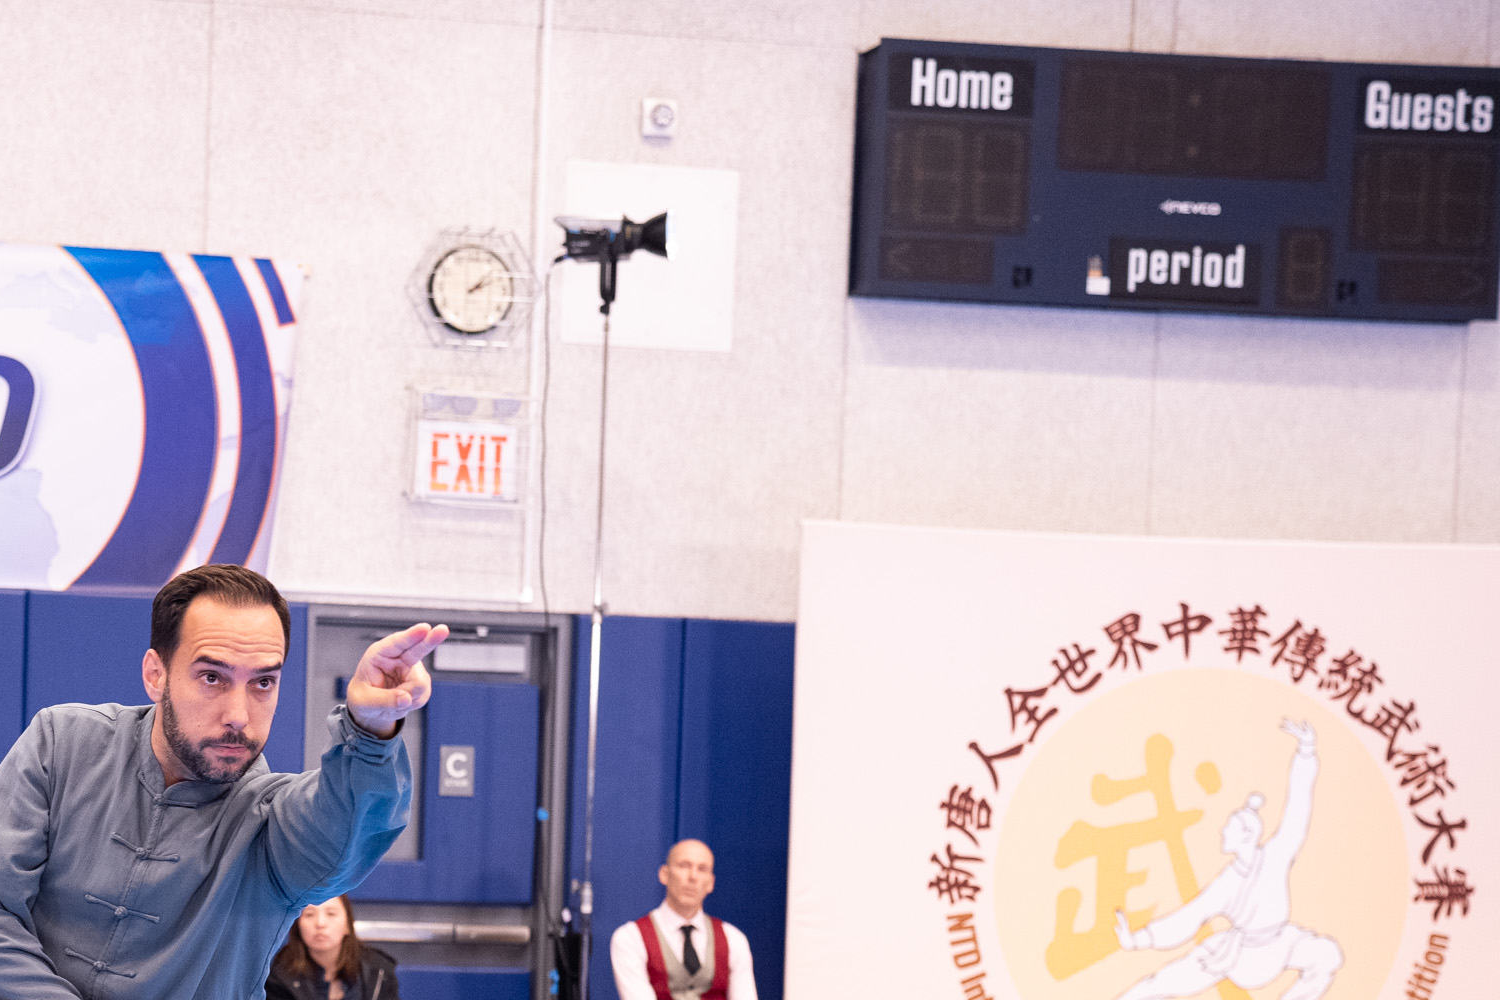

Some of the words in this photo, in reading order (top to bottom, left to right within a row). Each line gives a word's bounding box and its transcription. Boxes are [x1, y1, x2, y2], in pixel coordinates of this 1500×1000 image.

[911, 58, 1013, 110] Home
[1366, 82, 1492, 131] Guests
[1128, 245, 1245, 292] period
[430, 433, 507, 495] EXIT
[446, 752, 468, 779] C
[929, 603, 1474, 921] 新唐人全世界中華傳統武術大賽
[947, 913, 981, 968] NTD
